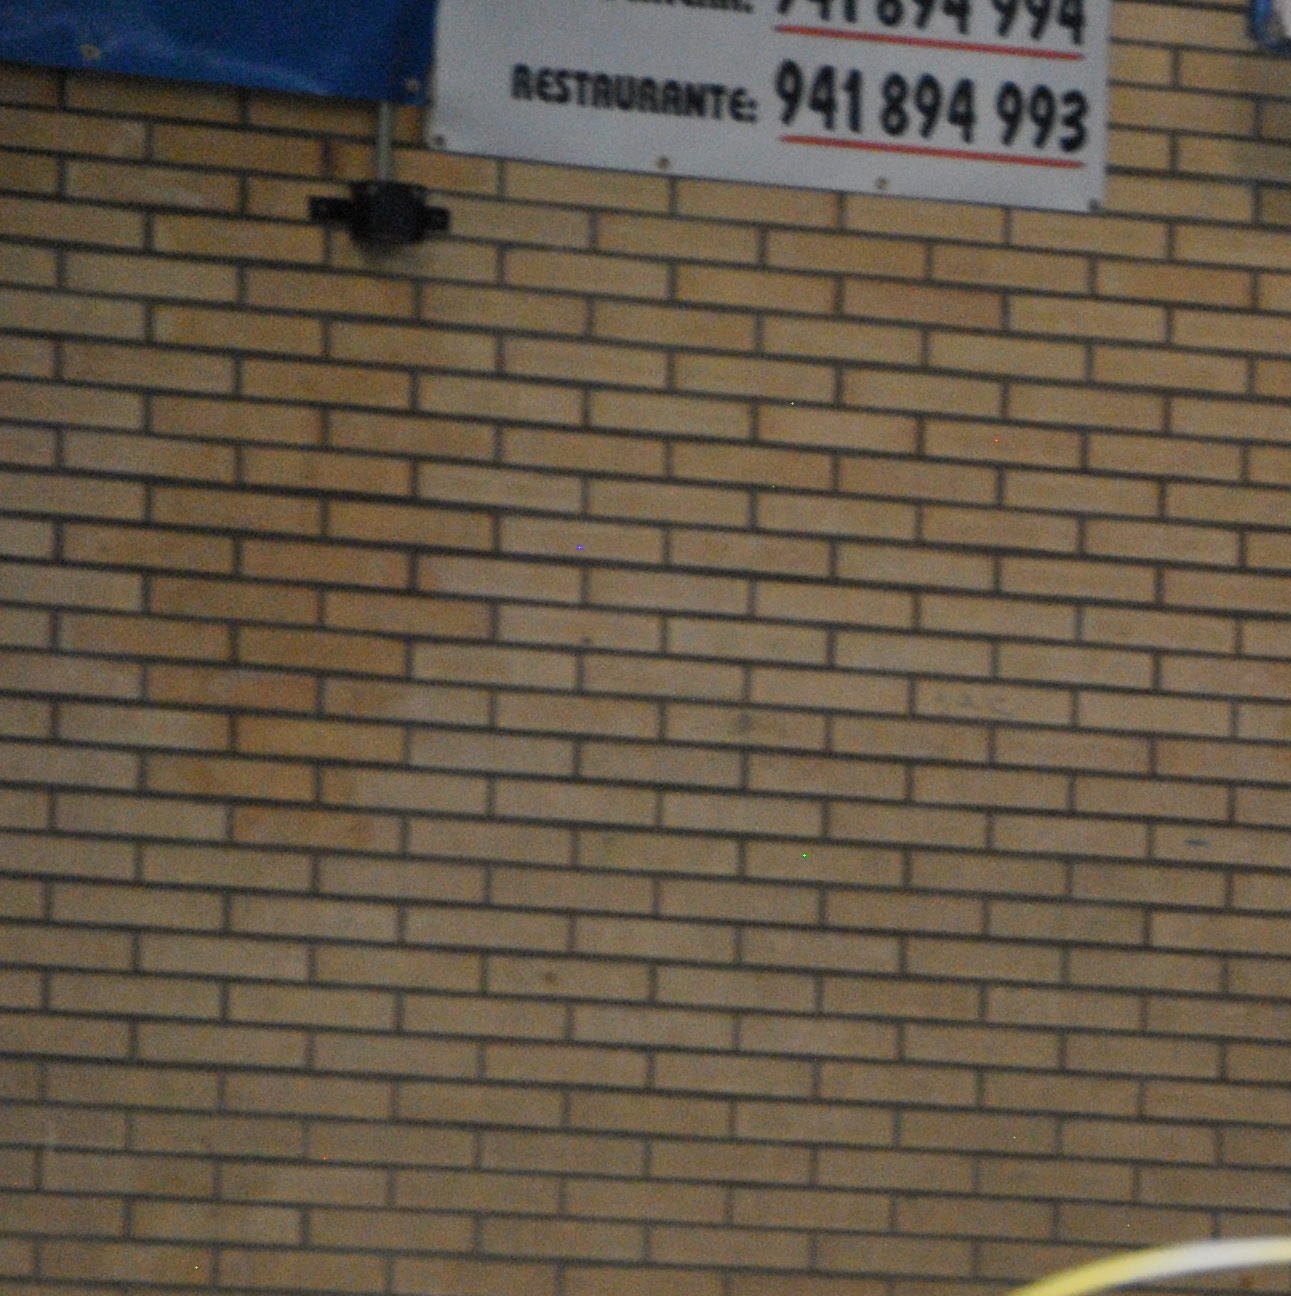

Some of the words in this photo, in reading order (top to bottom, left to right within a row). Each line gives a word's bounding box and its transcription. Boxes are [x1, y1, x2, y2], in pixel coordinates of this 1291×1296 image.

[510, 63, 758, 123] RESTAURANTE:
[774, 59, 863, 133] 941
[879, 72, 976, 143] 894
[996, 81, 1090, 153] 993
